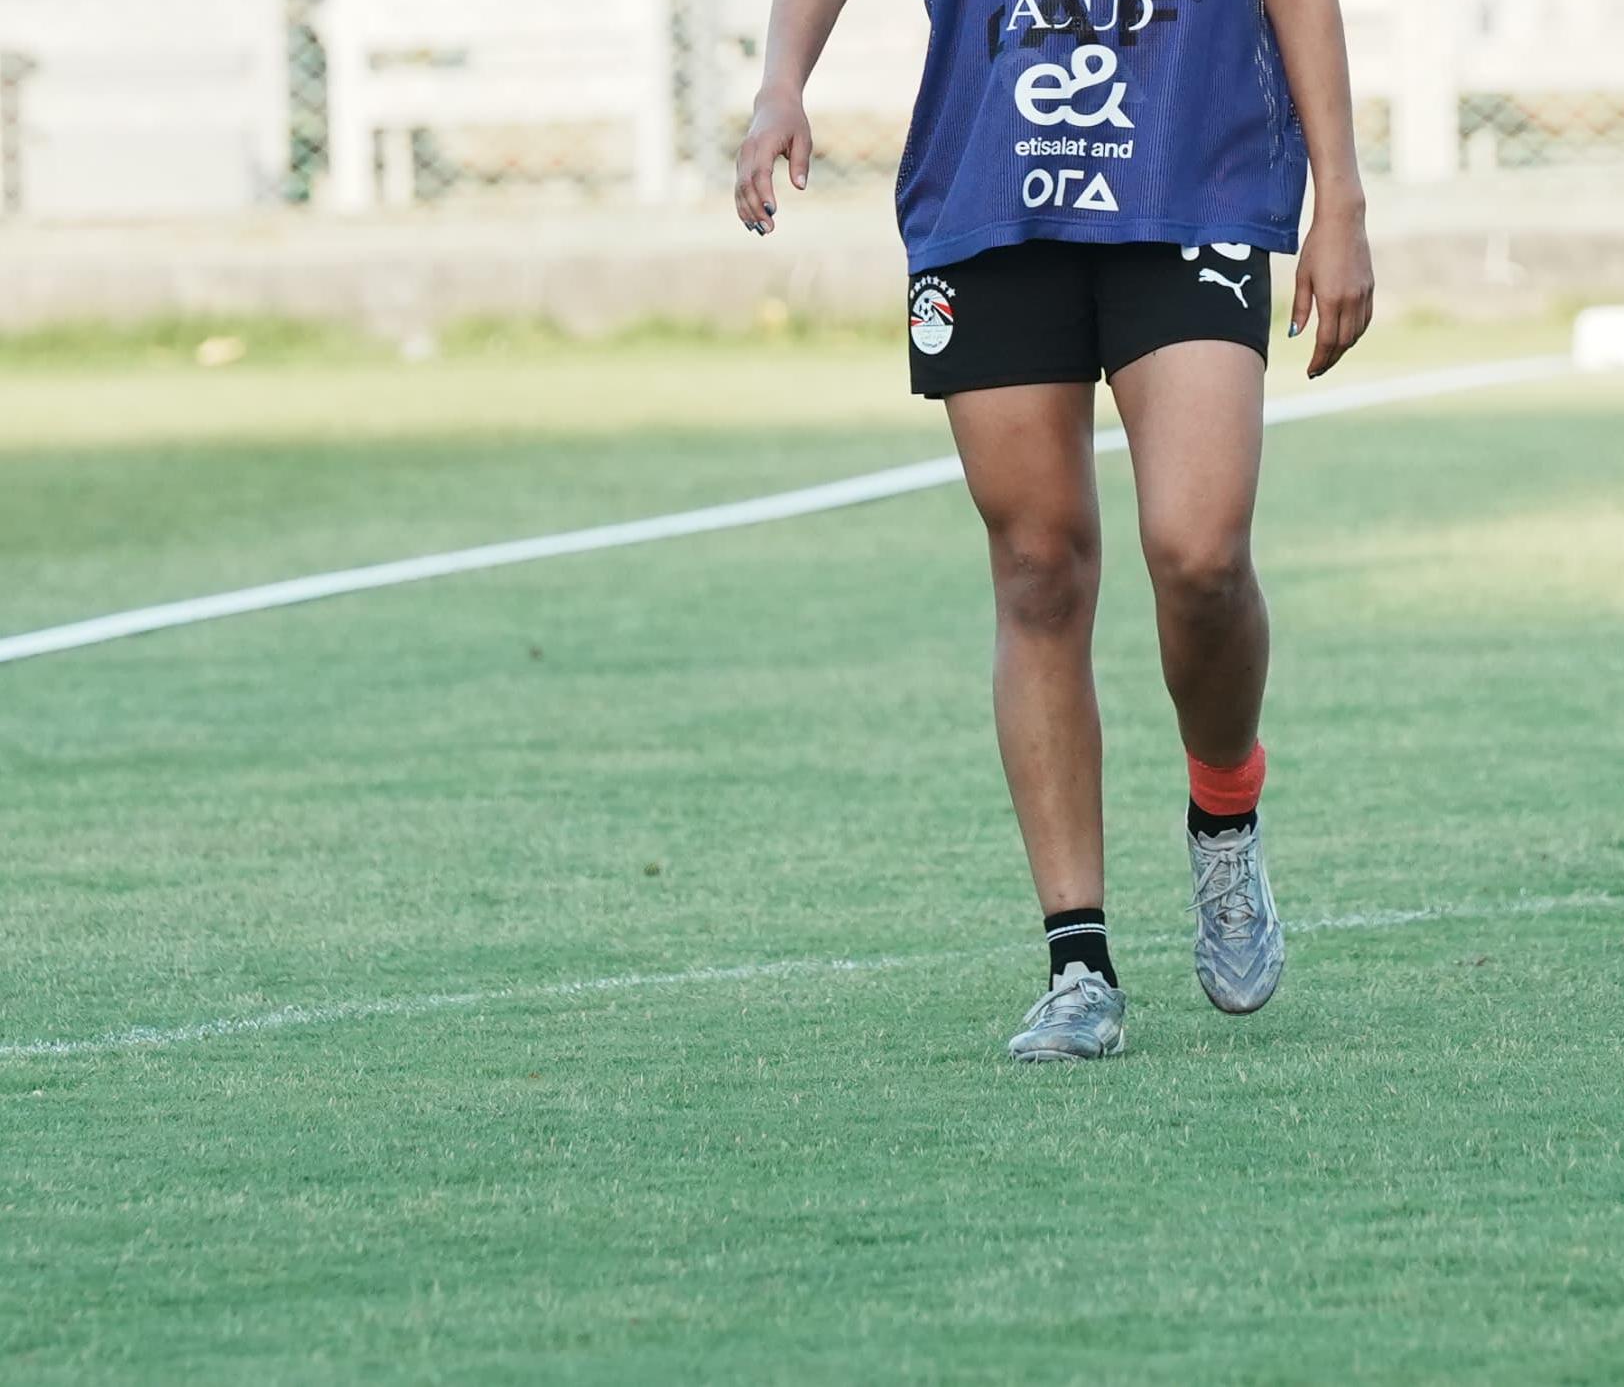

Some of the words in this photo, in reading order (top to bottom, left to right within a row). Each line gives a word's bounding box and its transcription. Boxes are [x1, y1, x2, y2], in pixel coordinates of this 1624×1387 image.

[1014, 44, 1135, 129] e&
[1015, 136, 1087, 158] etisalat
[1091, 139, 1134, 159] and
